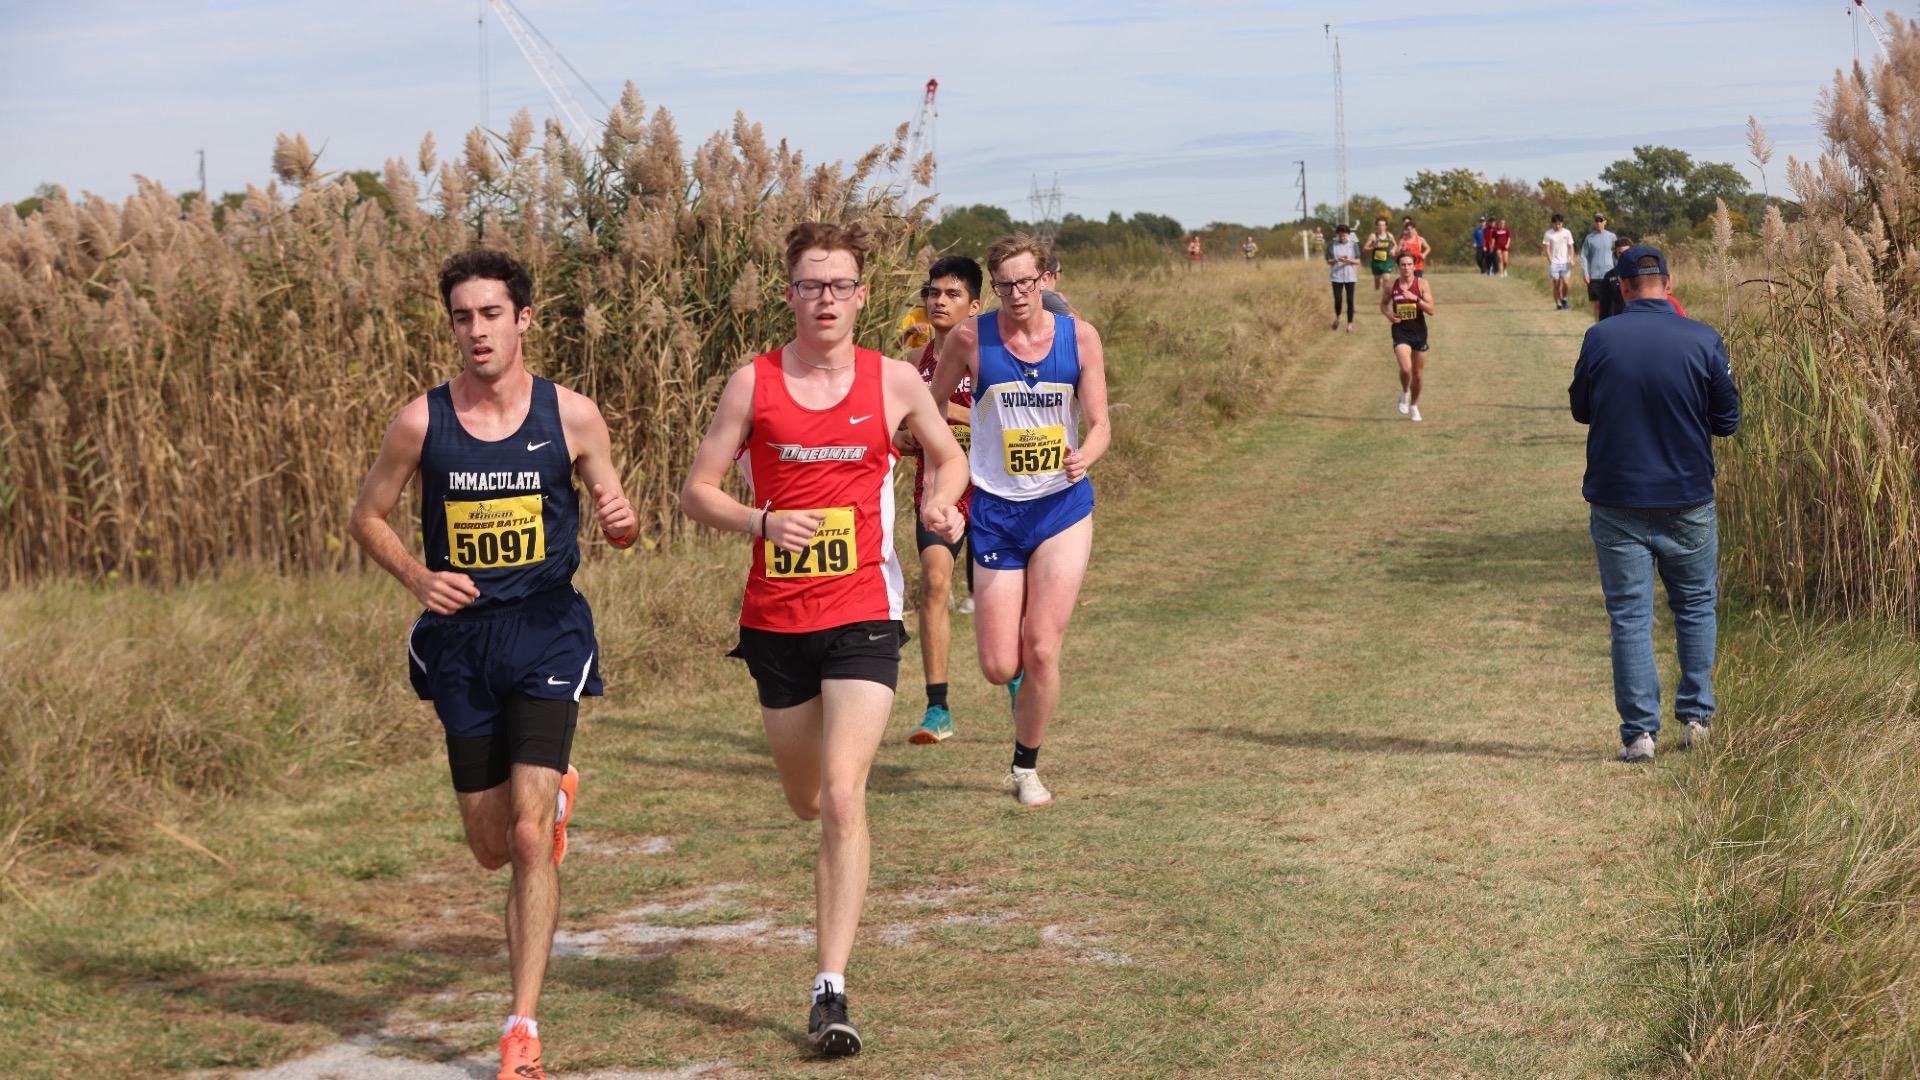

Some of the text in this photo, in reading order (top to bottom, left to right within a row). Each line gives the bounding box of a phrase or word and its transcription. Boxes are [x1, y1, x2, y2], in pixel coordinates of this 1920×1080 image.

[1001, 391, 1063, 408] WIDENER
[776, 443, 866, 462] ONEONTA
[1010, 446, 1060, 473] 5527
[449, 472, 541, 491] IMMACULATA
[453, 515, 537, 530] BORDER BATTLE
[456, 527, 537, 565] 5097
[774, 538, 849, 575] 5219
